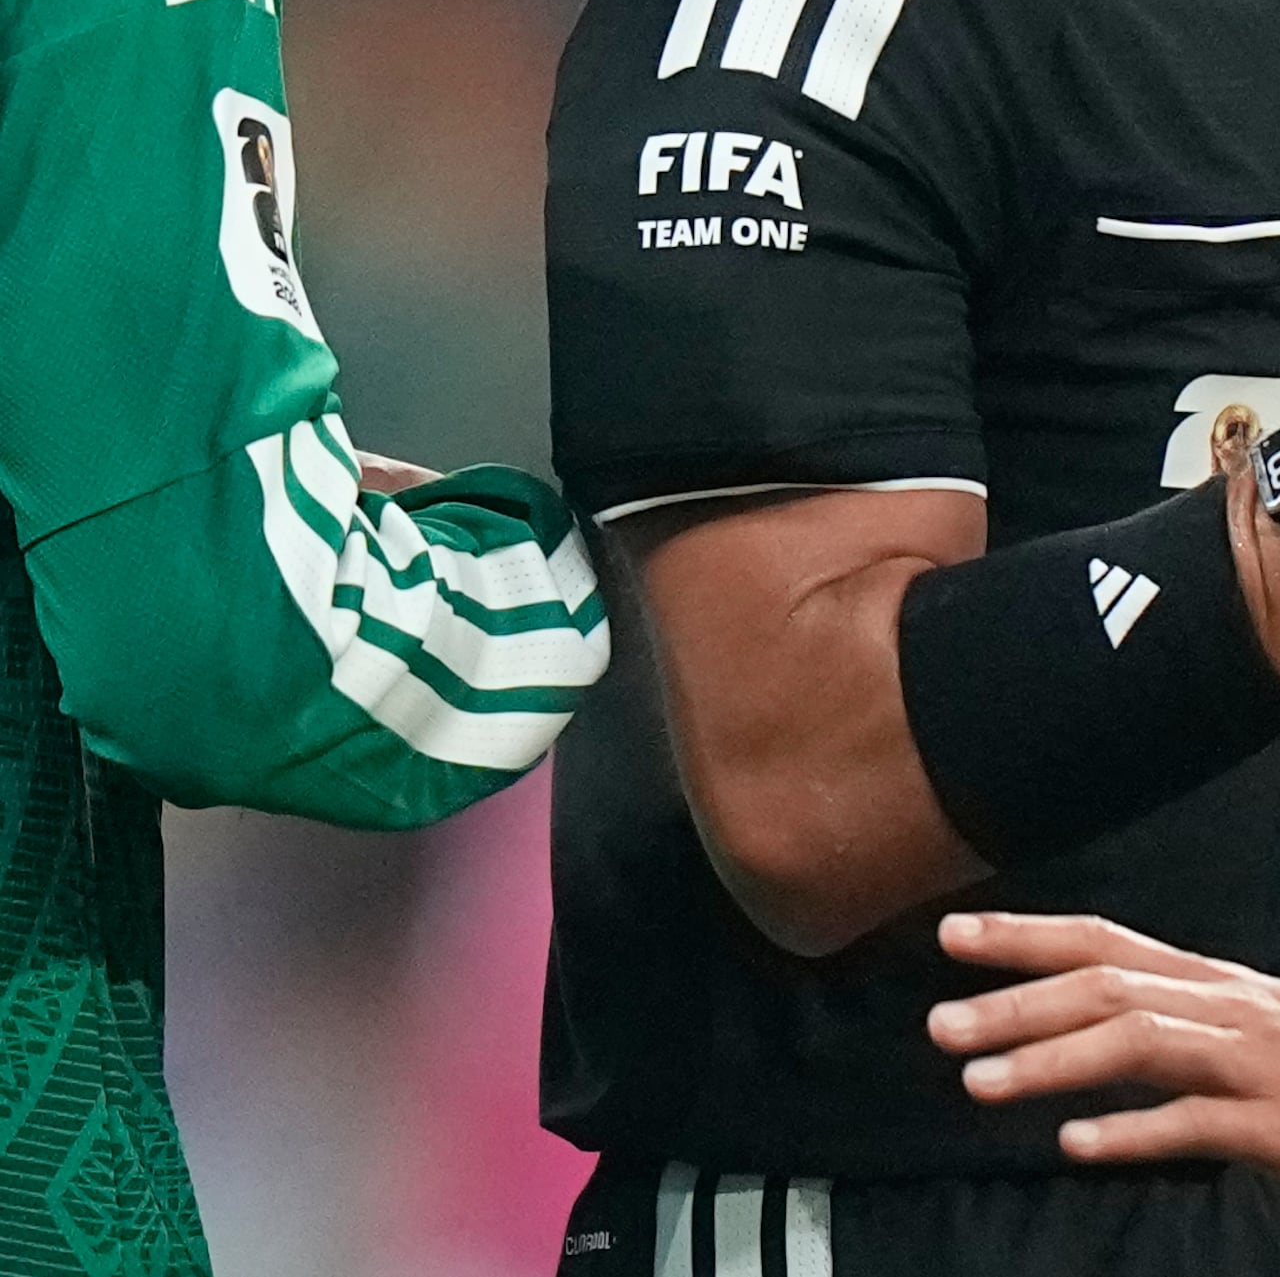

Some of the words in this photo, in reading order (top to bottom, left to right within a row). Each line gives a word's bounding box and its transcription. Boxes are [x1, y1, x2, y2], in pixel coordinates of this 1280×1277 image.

[638, 131, 803, 210] FIFA
[638, 217, 722, 249] TEAM
[731, 217, 809, 252] ONE
